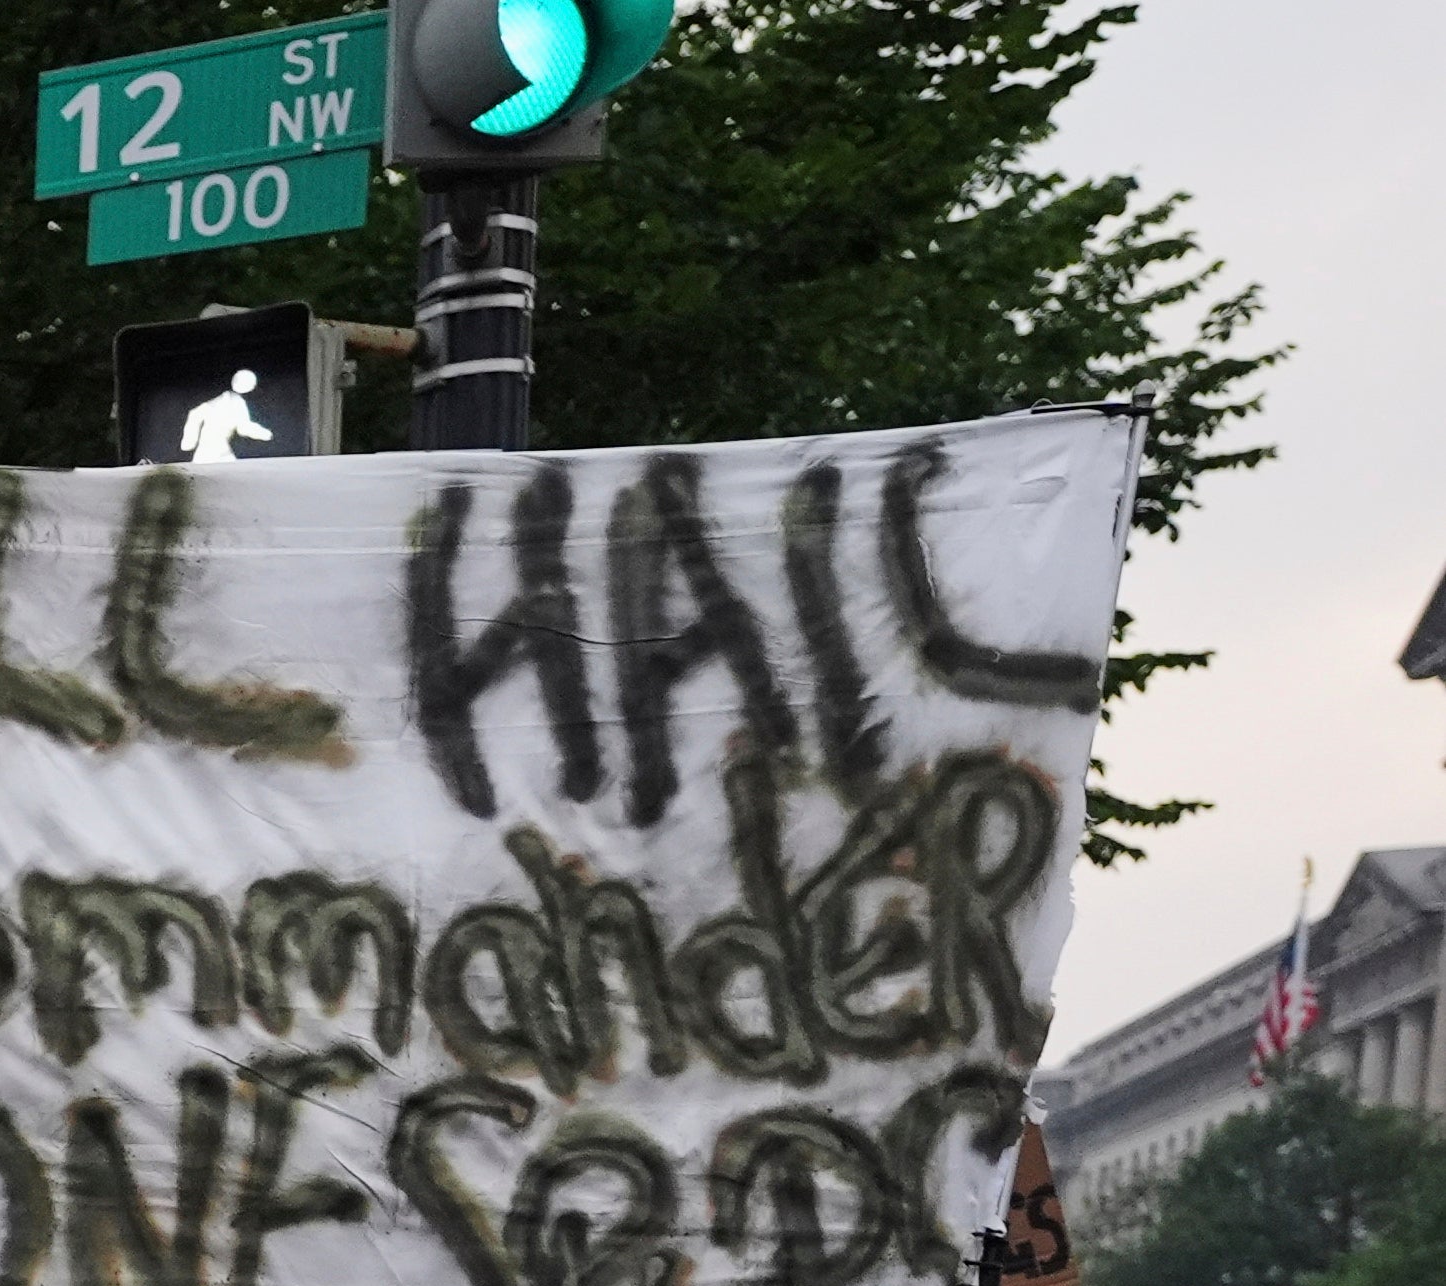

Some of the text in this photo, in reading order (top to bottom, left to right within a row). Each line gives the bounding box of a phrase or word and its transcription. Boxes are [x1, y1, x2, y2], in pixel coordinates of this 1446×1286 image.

[283, 32, 350, 85] ST
[61, 71, 184, 174] 12
[268, 88, 355, 148] NW
[166, 165, 290, 241] 100
[405, 445, 1105, 830] HAIL
